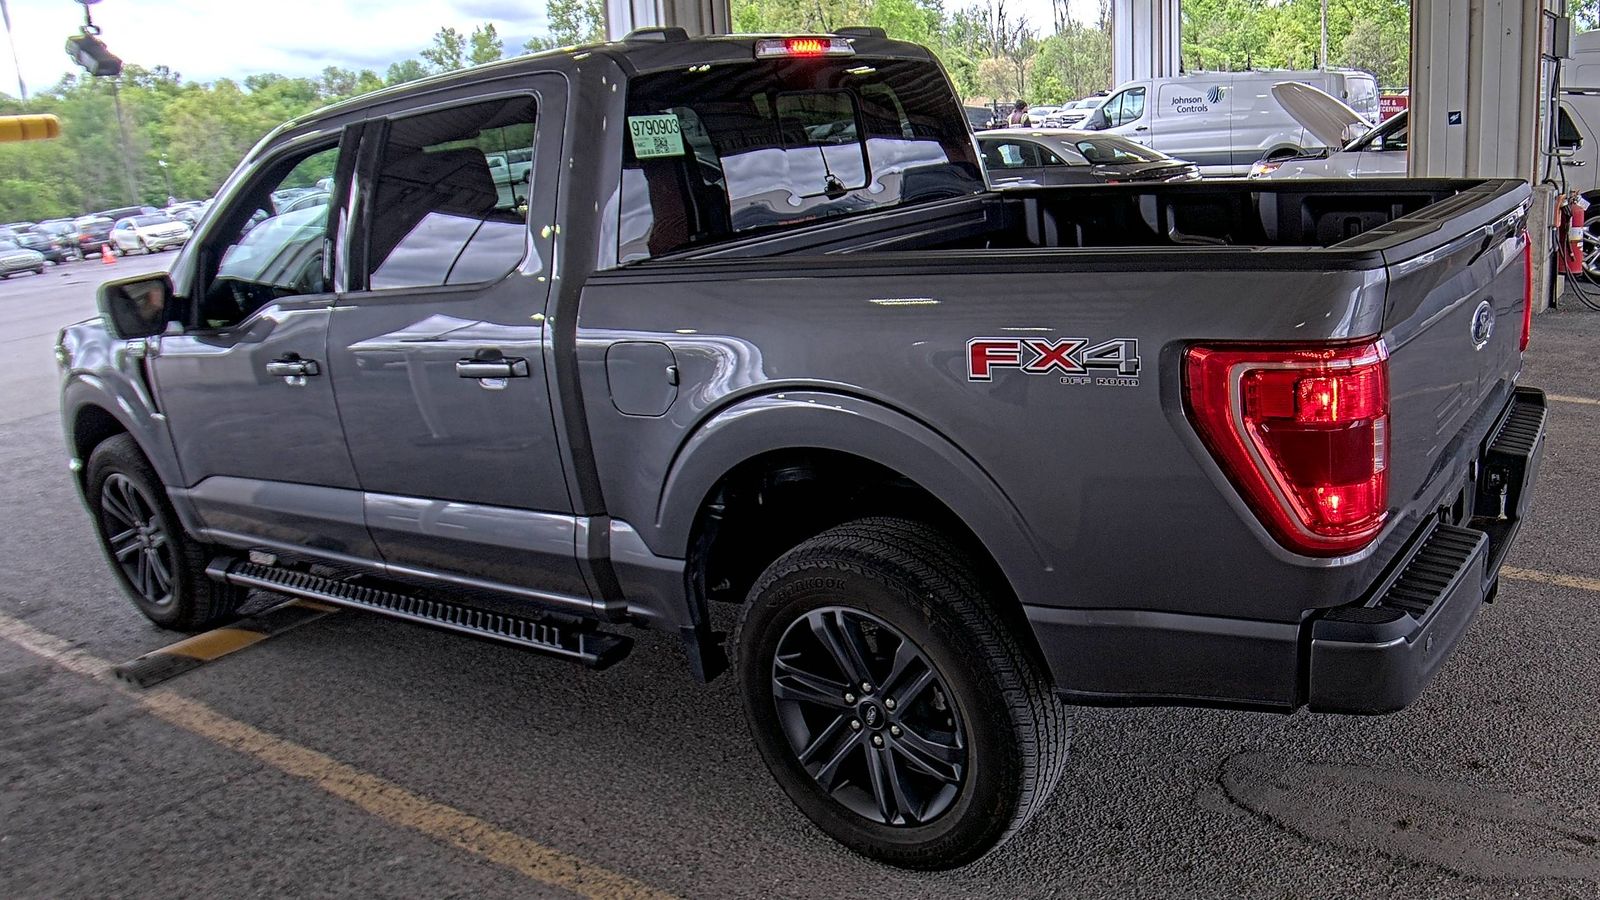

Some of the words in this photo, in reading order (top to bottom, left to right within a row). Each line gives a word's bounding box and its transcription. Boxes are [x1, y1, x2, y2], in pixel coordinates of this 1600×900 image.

[1171, 96, 1203, 105] Johnson
[1176, 104, 1209, 113] Controls
[631, 118, 680, 137] 9790903
[966, 337, 1141, 382] FX4
[1060, 376, 1092, 385] OFF
[1096, 377, 1140, 387] ROAD
